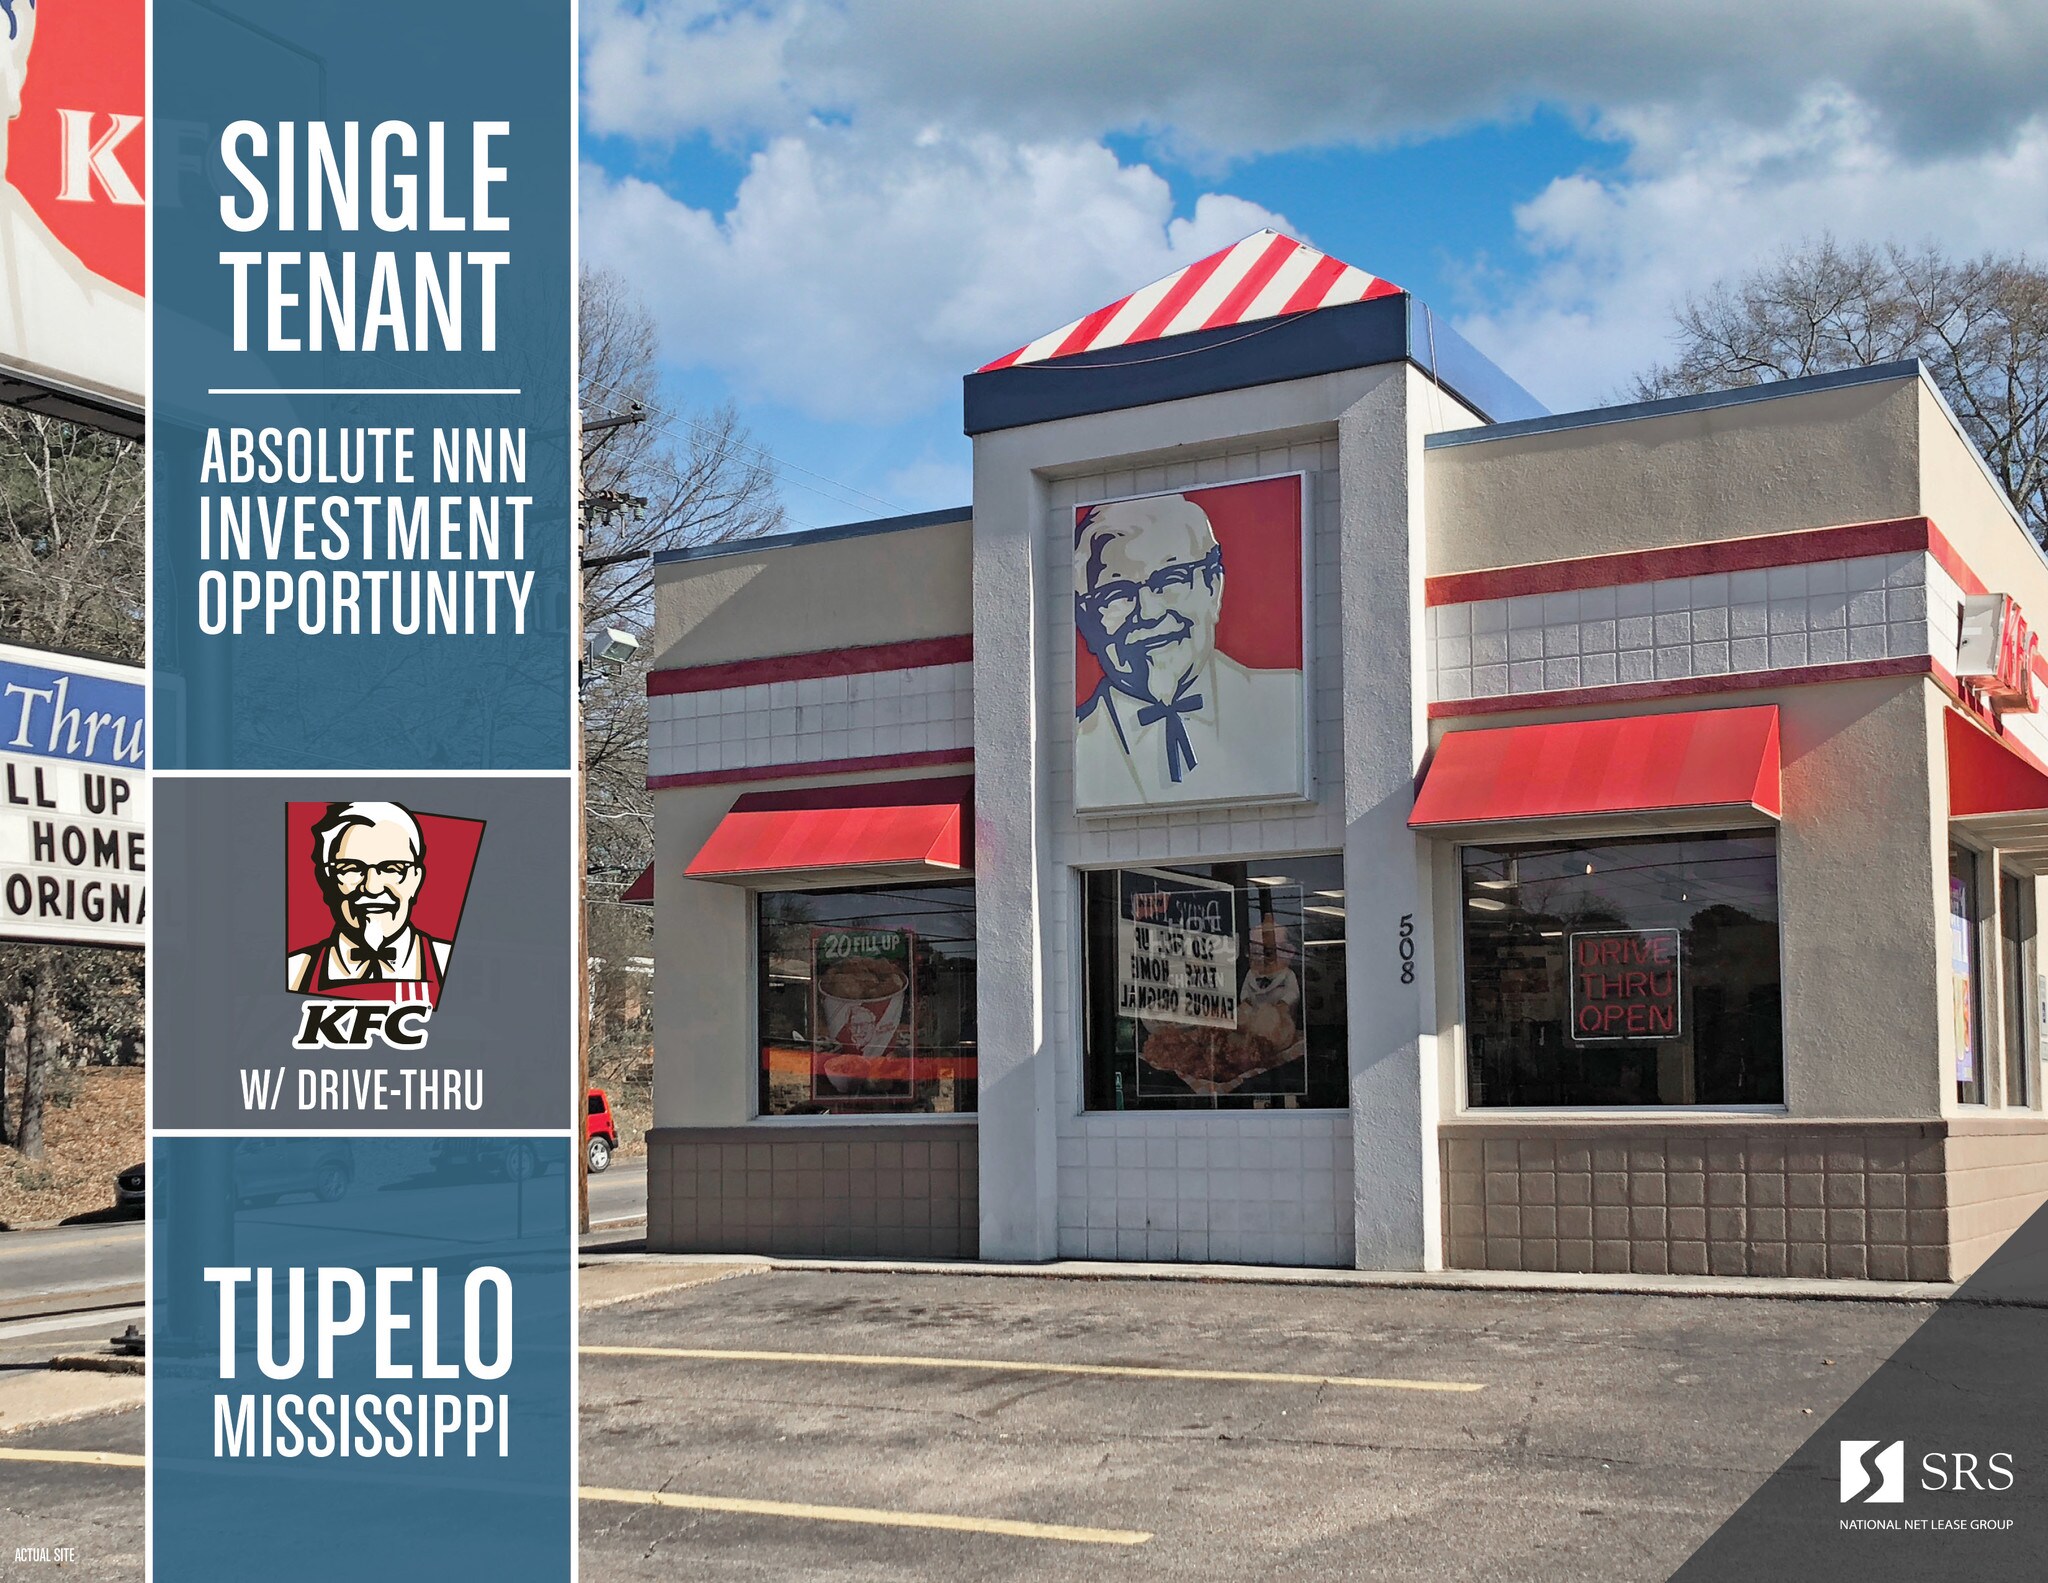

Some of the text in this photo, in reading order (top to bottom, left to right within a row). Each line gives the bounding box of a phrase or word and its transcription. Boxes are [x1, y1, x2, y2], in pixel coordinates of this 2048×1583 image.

[4, 675, 145, 764] Thru
[84, 773, 131, 816] UP
[33, 820, 145, 872] HOME
[1399, 913, 1415, 984] 508
[1579, 937, 1671, 967] DRIVE
[1580, 970, 1672, 1000] THRU
[1579, 1004, 1673, 1031] OPEN
